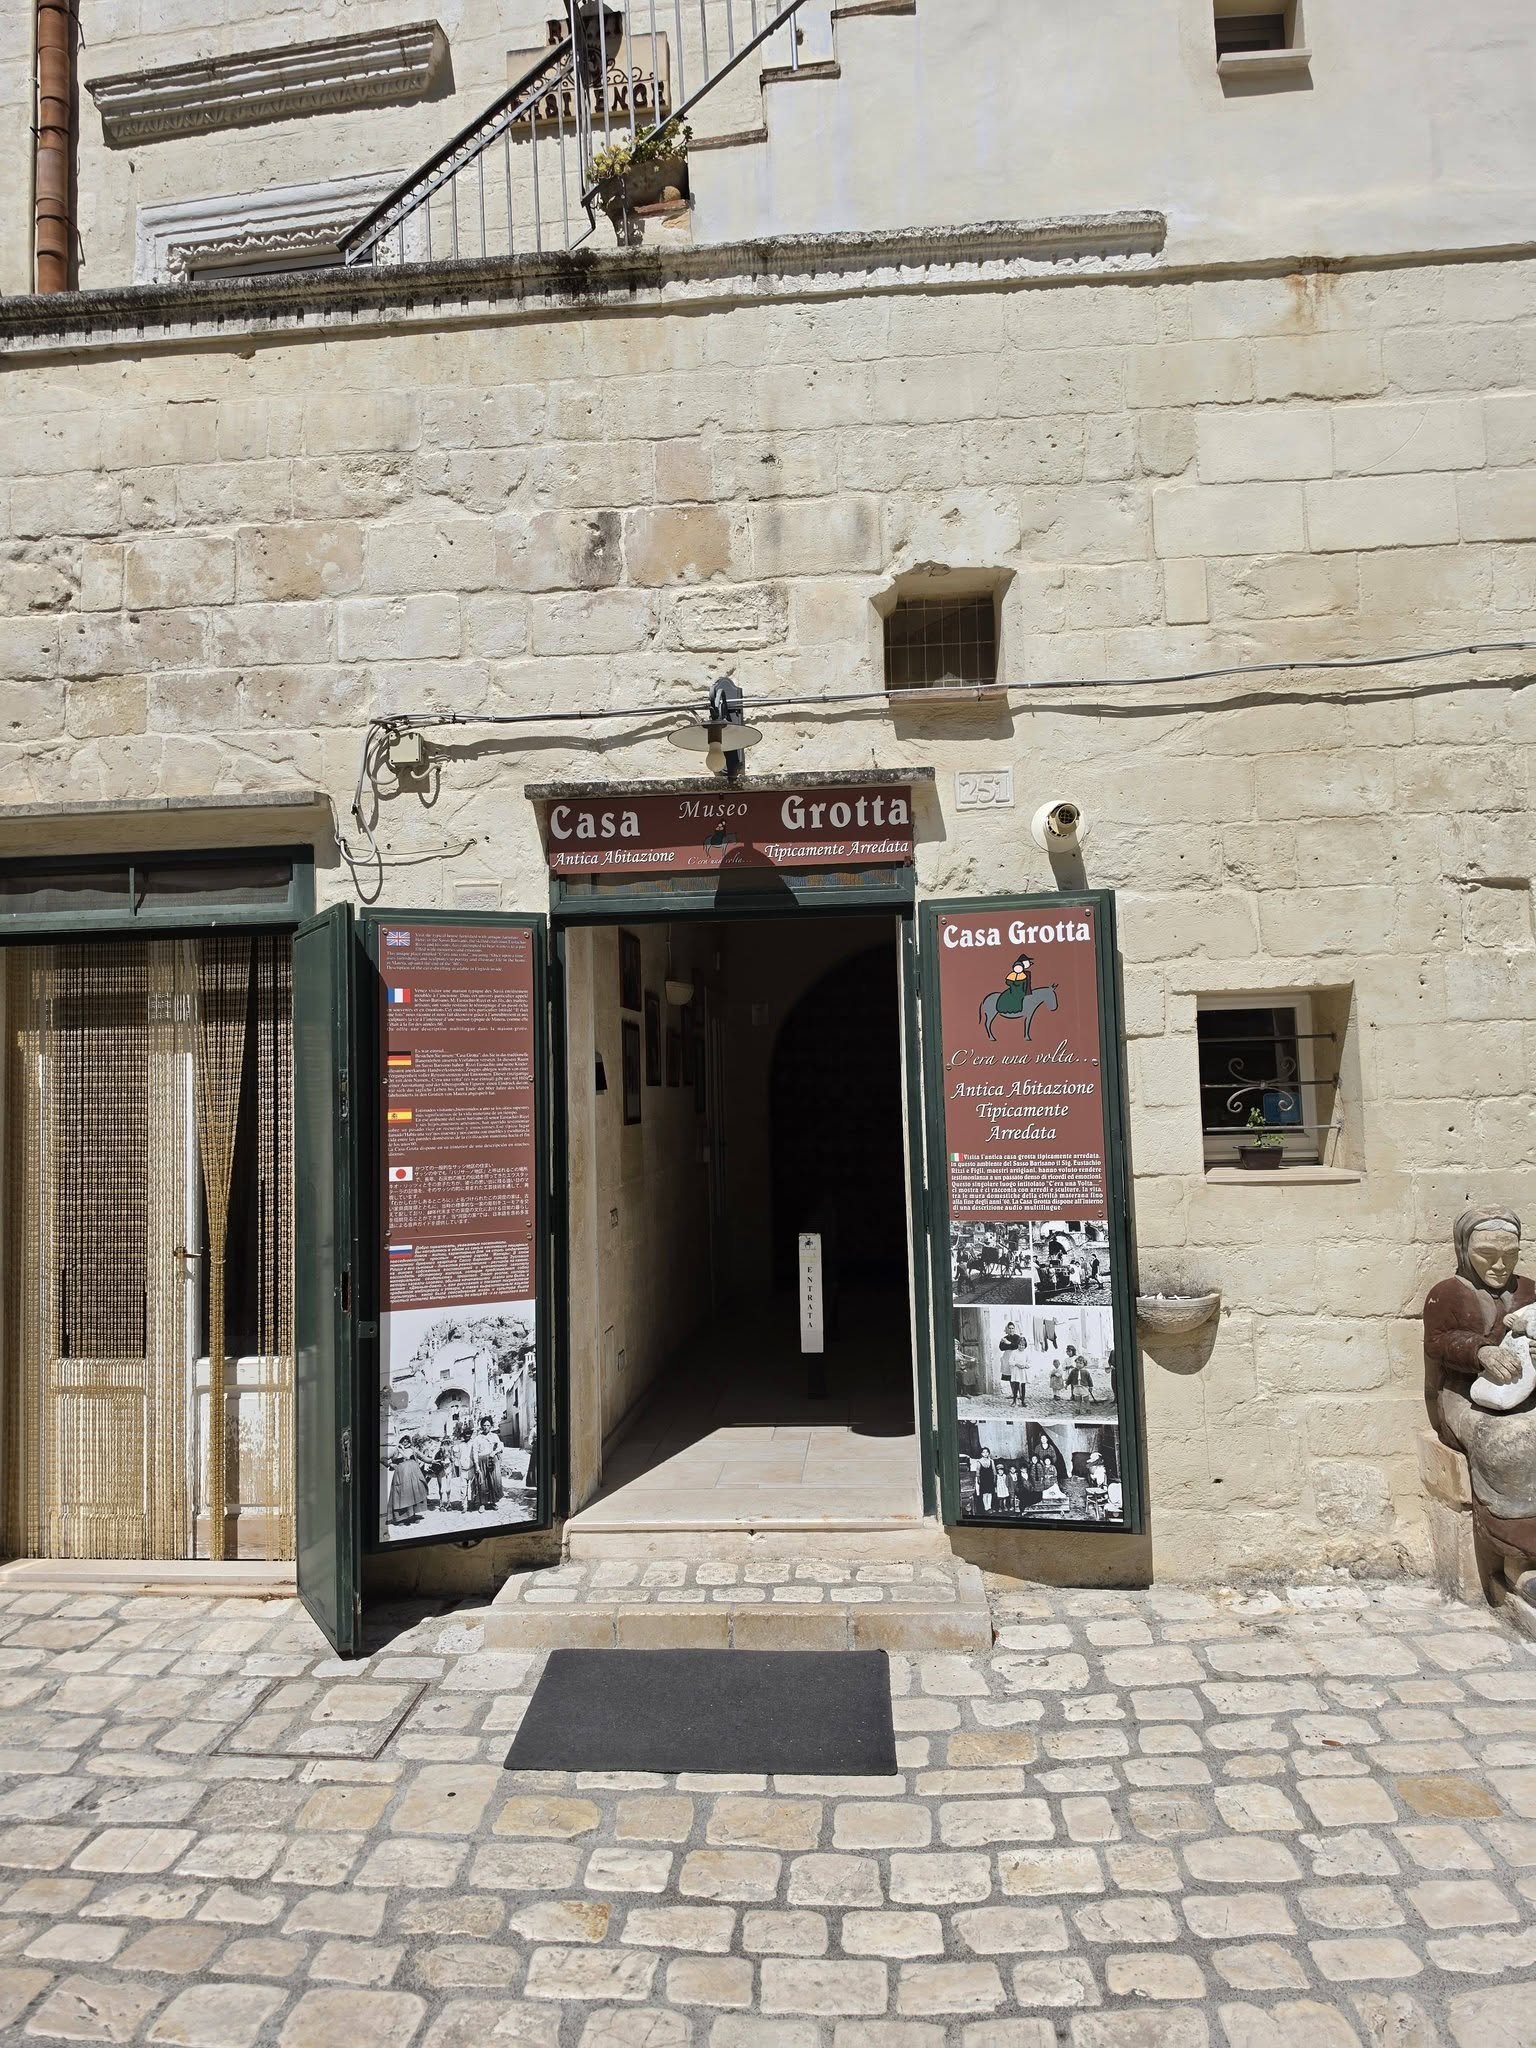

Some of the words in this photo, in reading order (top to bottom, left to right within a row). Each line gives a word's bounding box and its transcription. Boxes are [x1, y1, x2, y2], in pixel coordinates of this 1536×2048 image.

[959, 775, 1010, 804] 251
[550, 805, 641, 840] Casa
[678, 800, 748, 820] Museo
[781, 795, 909, 830] Grotta
[552, 852, 599, 868] Antica
[600, 849, 675, 866] Abitazione
[764, 844, 845, 862] Tipicamente
[846, 838, 909, 856] Arredata
[944, 925, 1002, 949] Casa
[1008, 920, 1091, 945] Grotta
[951, 1049, 998, 1066] C'era
[1001, 1054, 1029, 1064] una
[951, 1082, 1004, 1099] Antica
[1006, 1079, 1095, 1098] Abitazione
[976, 1103, 1069, 1123] Tipicamente
[986, 1123, 1057, 1142] Arredata
